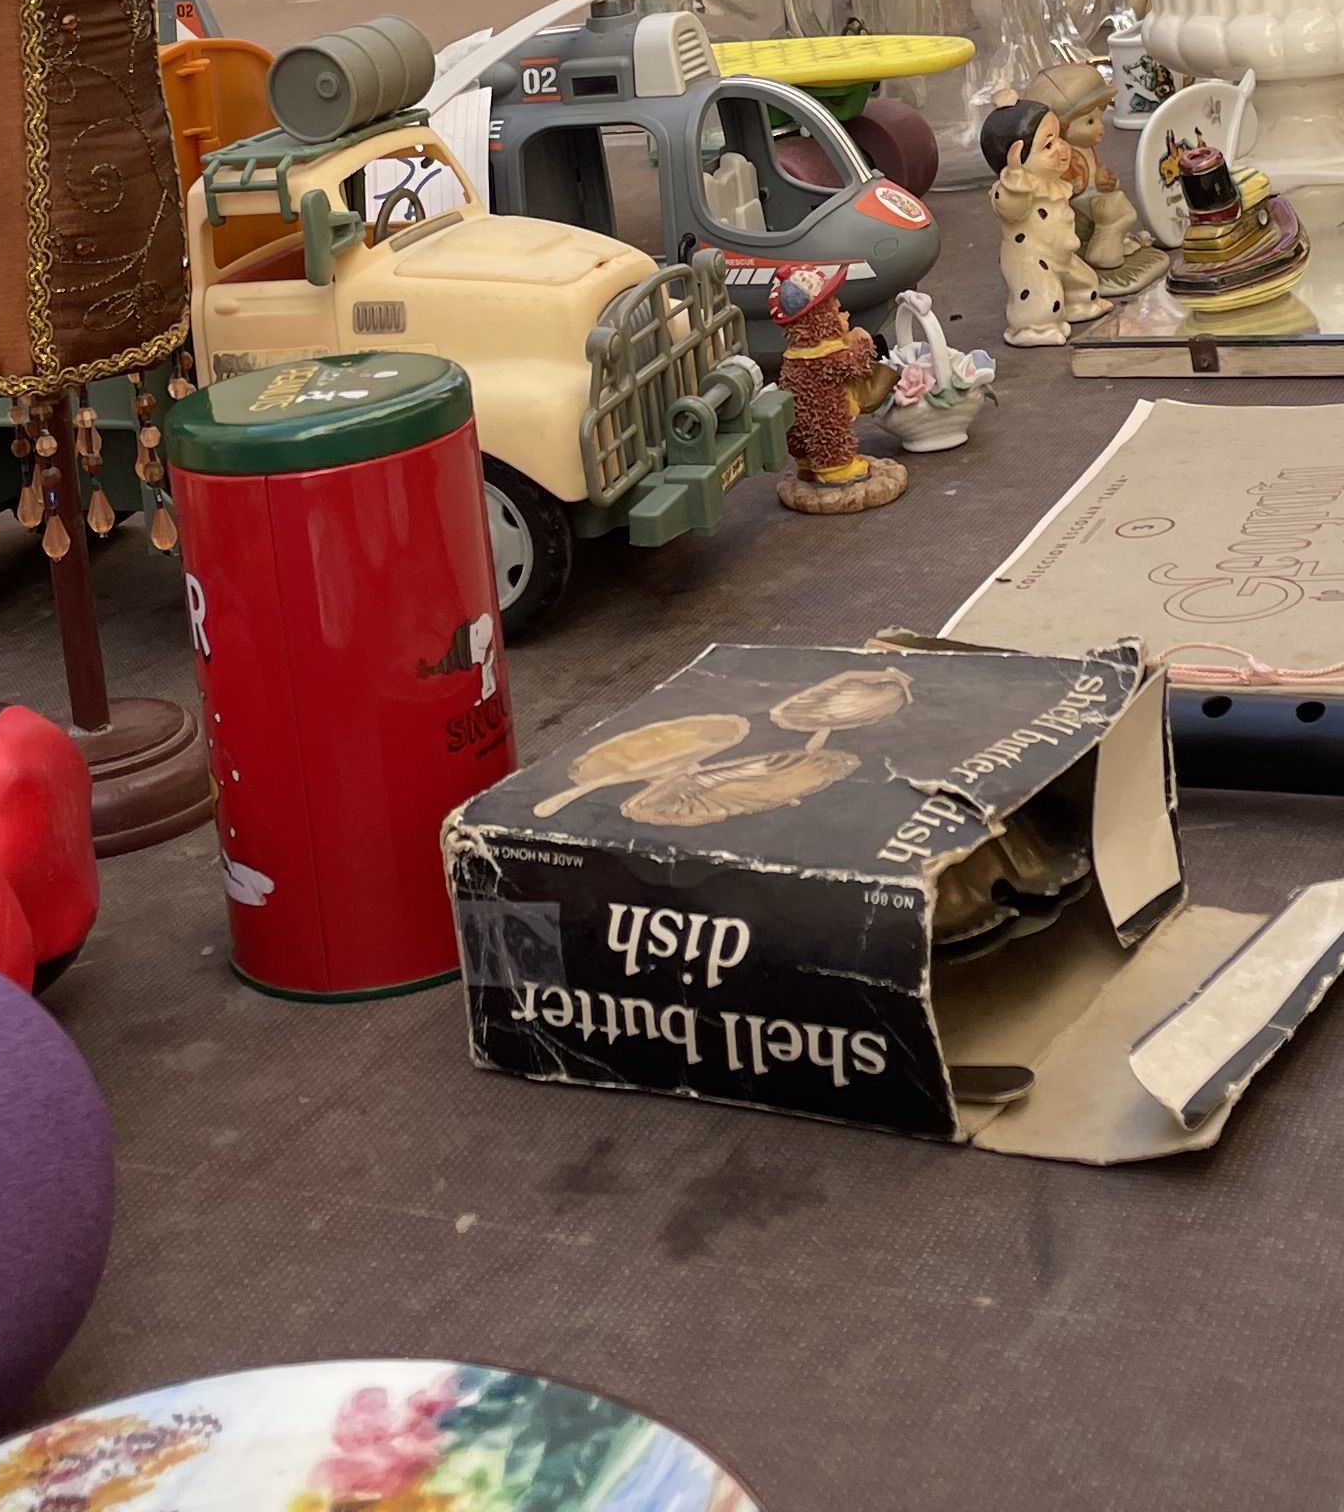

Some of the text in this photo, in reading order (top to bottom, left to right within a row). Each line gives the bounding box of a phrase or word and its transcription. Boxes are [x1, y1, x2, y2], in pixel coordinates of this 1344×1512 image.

[176, 4, 194, 18] 02
[522, 67, 558, 95] 02
[876, 674, 1107, 864] shell butter dish
[502, 846, 536, 863] HONG
[538, 849, 551, 864] IN
[553, 851, 584, 868] MADE
[606, 902, 751, 989] dish
[511, 981, 889, 1089] shell butter
